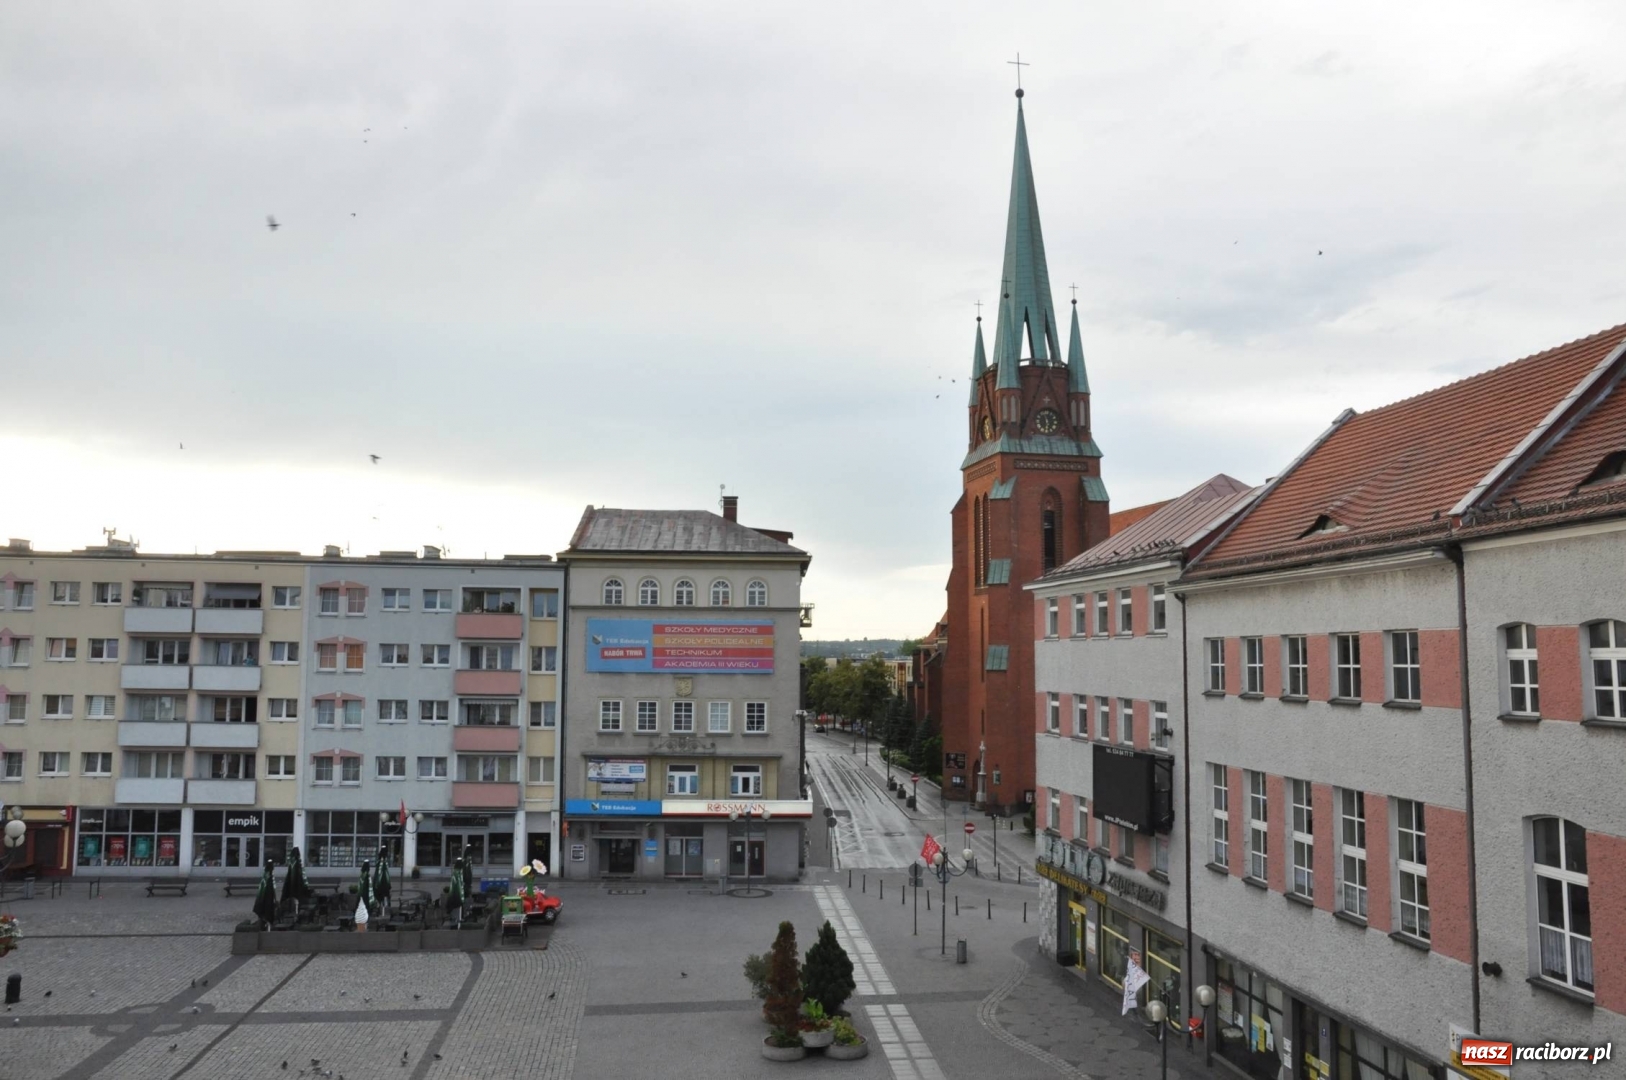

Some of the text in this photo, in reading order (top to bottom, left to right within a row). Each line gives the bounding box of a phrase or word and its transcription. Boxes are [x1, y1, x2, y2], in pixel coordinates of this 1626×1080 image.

[664, 626, 702, 634] SZKOŁY
[704, 638, 764, 646] POLICEALNE
[603, 649, 624, 657] NABÓR
[228, 815, 260, 827] empik
